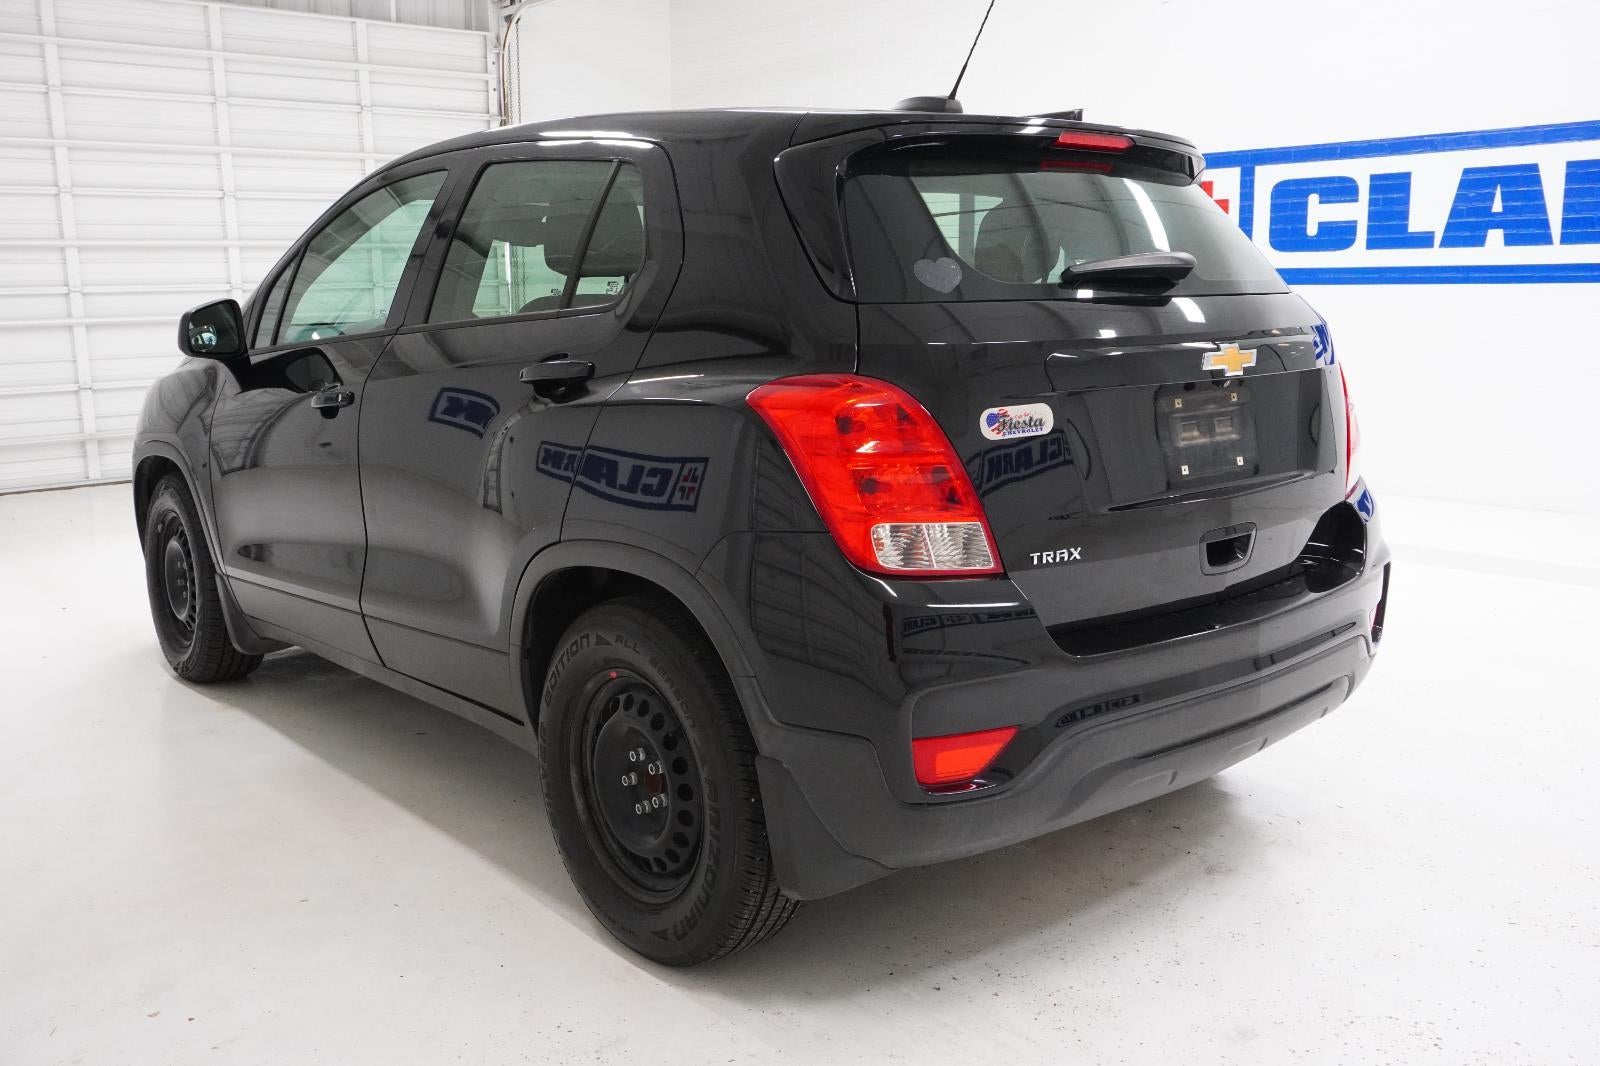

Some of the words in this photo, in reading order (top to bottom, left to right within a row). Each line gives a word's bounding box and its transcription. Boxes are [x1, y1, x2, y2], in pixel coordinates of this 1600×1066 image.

[998, 415, 1045, 432] Fiesta
[1002, 427, 1043, 437] CHEVROLET
[1030, 547, 1082, 565] TRAX
[545, 632, 590, 707] EDITION
[615, 634, 641, 655] ALL
